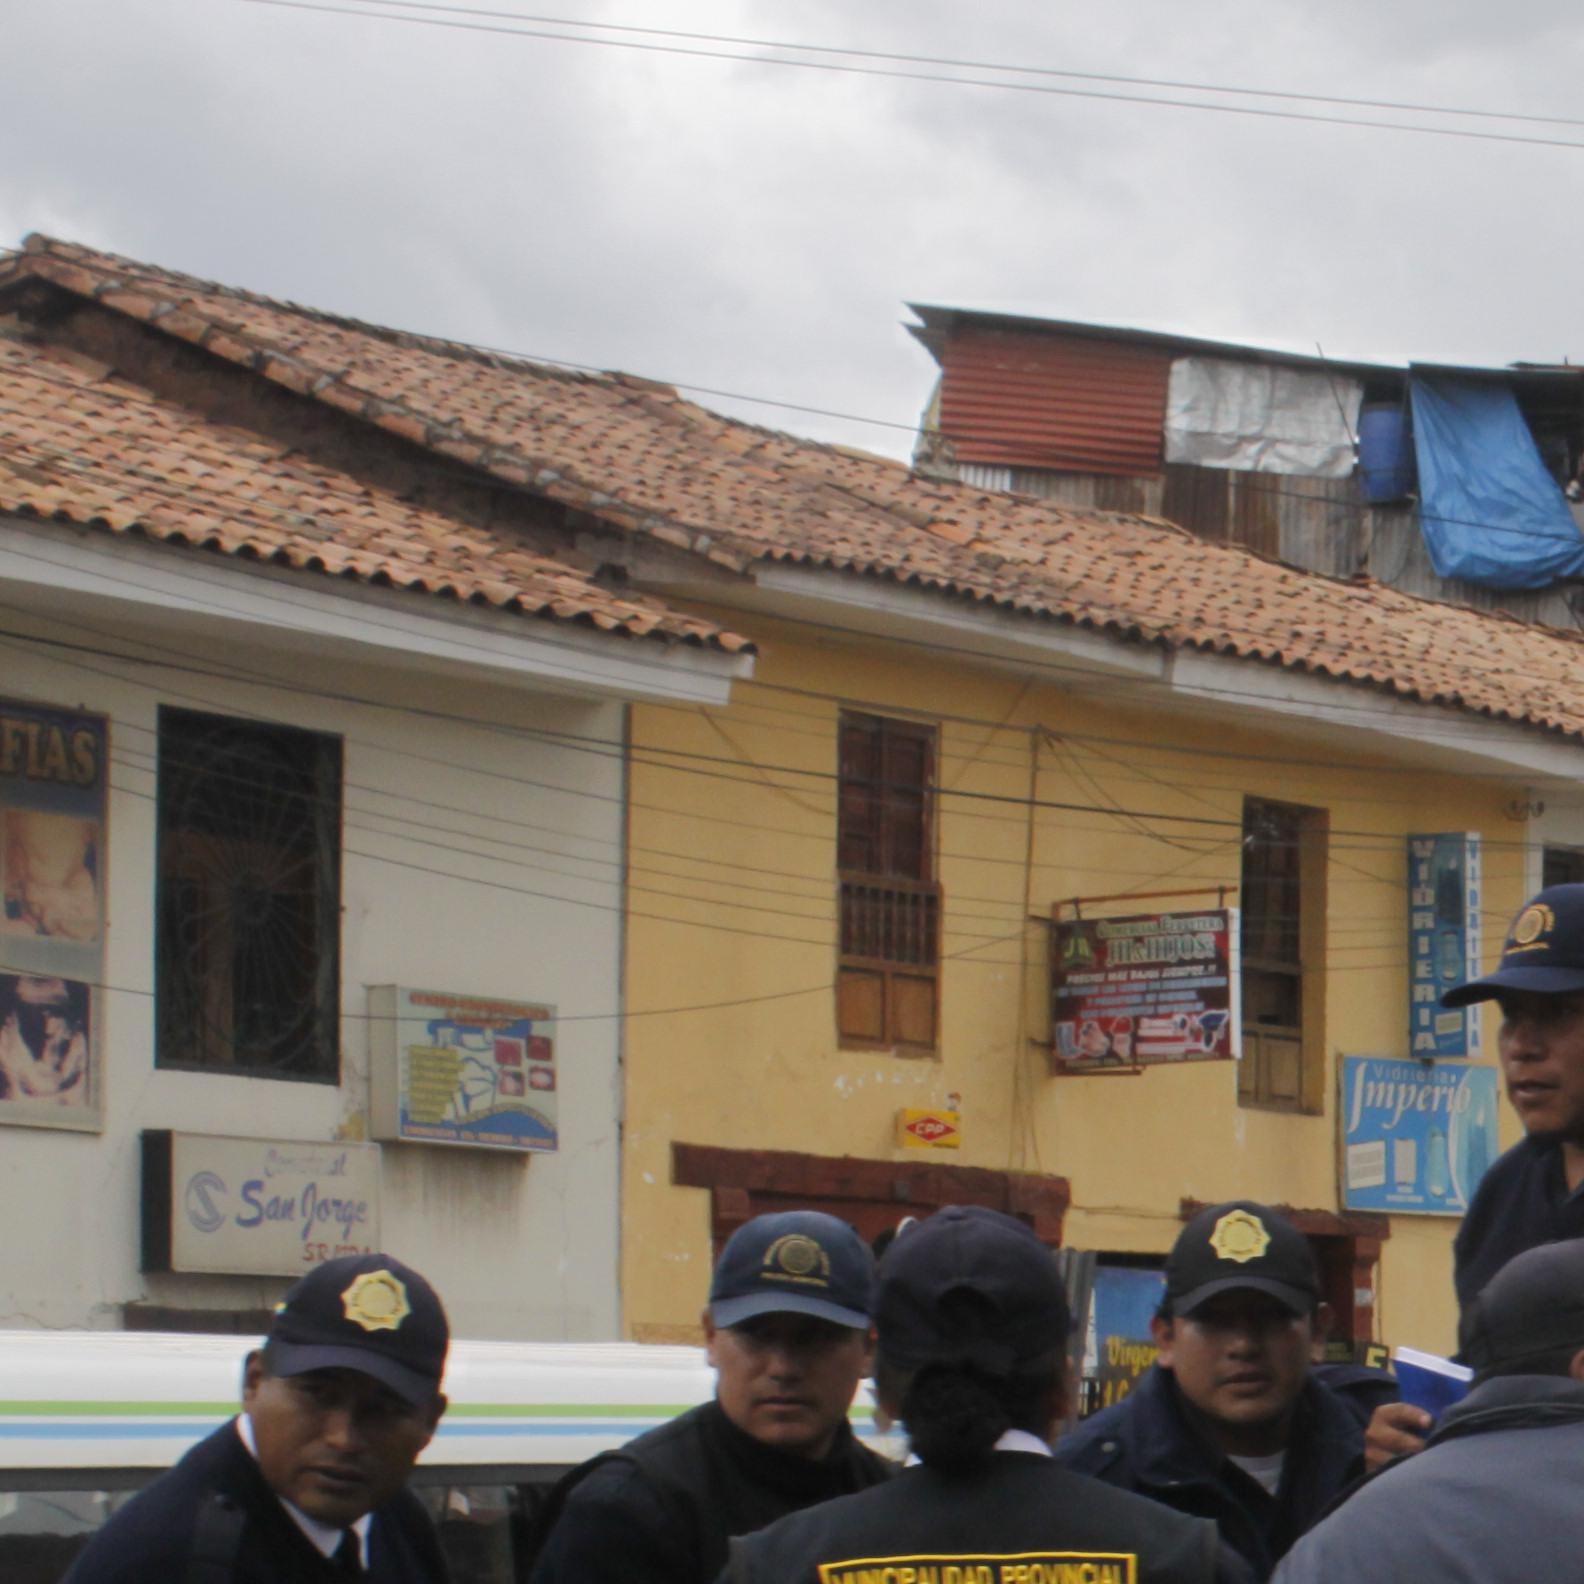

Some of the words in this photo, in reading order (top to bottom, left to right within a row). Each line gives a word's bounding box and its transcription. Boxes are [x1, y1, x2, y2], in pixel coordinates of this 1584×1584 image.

[1346, 1061, 1472, 1134] Imperio
[234, 1179, 296, 1228] San
[302, 1182, 369, 1240] Jorge
